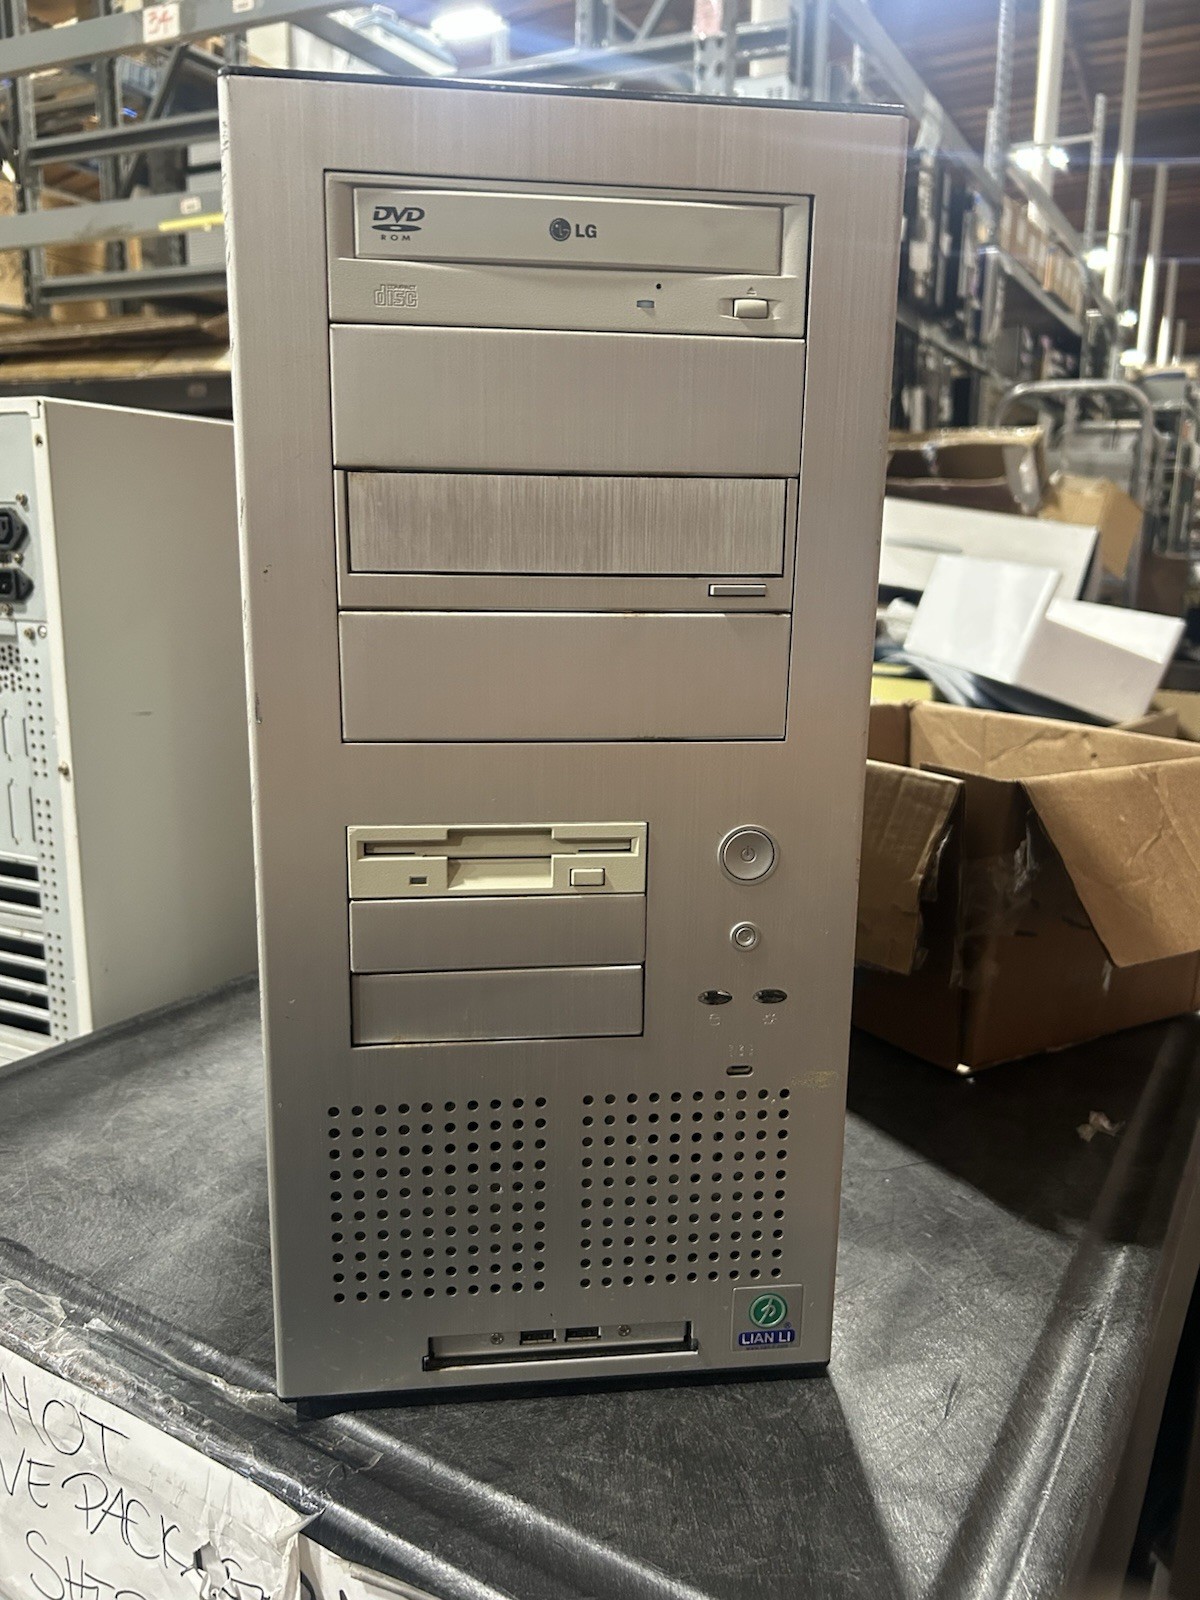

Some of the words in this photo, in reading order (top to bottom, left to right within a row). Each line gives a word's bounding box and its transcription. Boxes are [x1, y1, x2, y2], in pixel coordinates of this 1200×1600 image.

[373, 206, 425, 223] DVD
[575, 223, 597, 238] LG
[374, 284, 418, 308] disc
[741, 1332, 775, 1345] LIAN
[778, 1331, 791, 1342] LI
[2, 1372, 130, 1476] NOT
